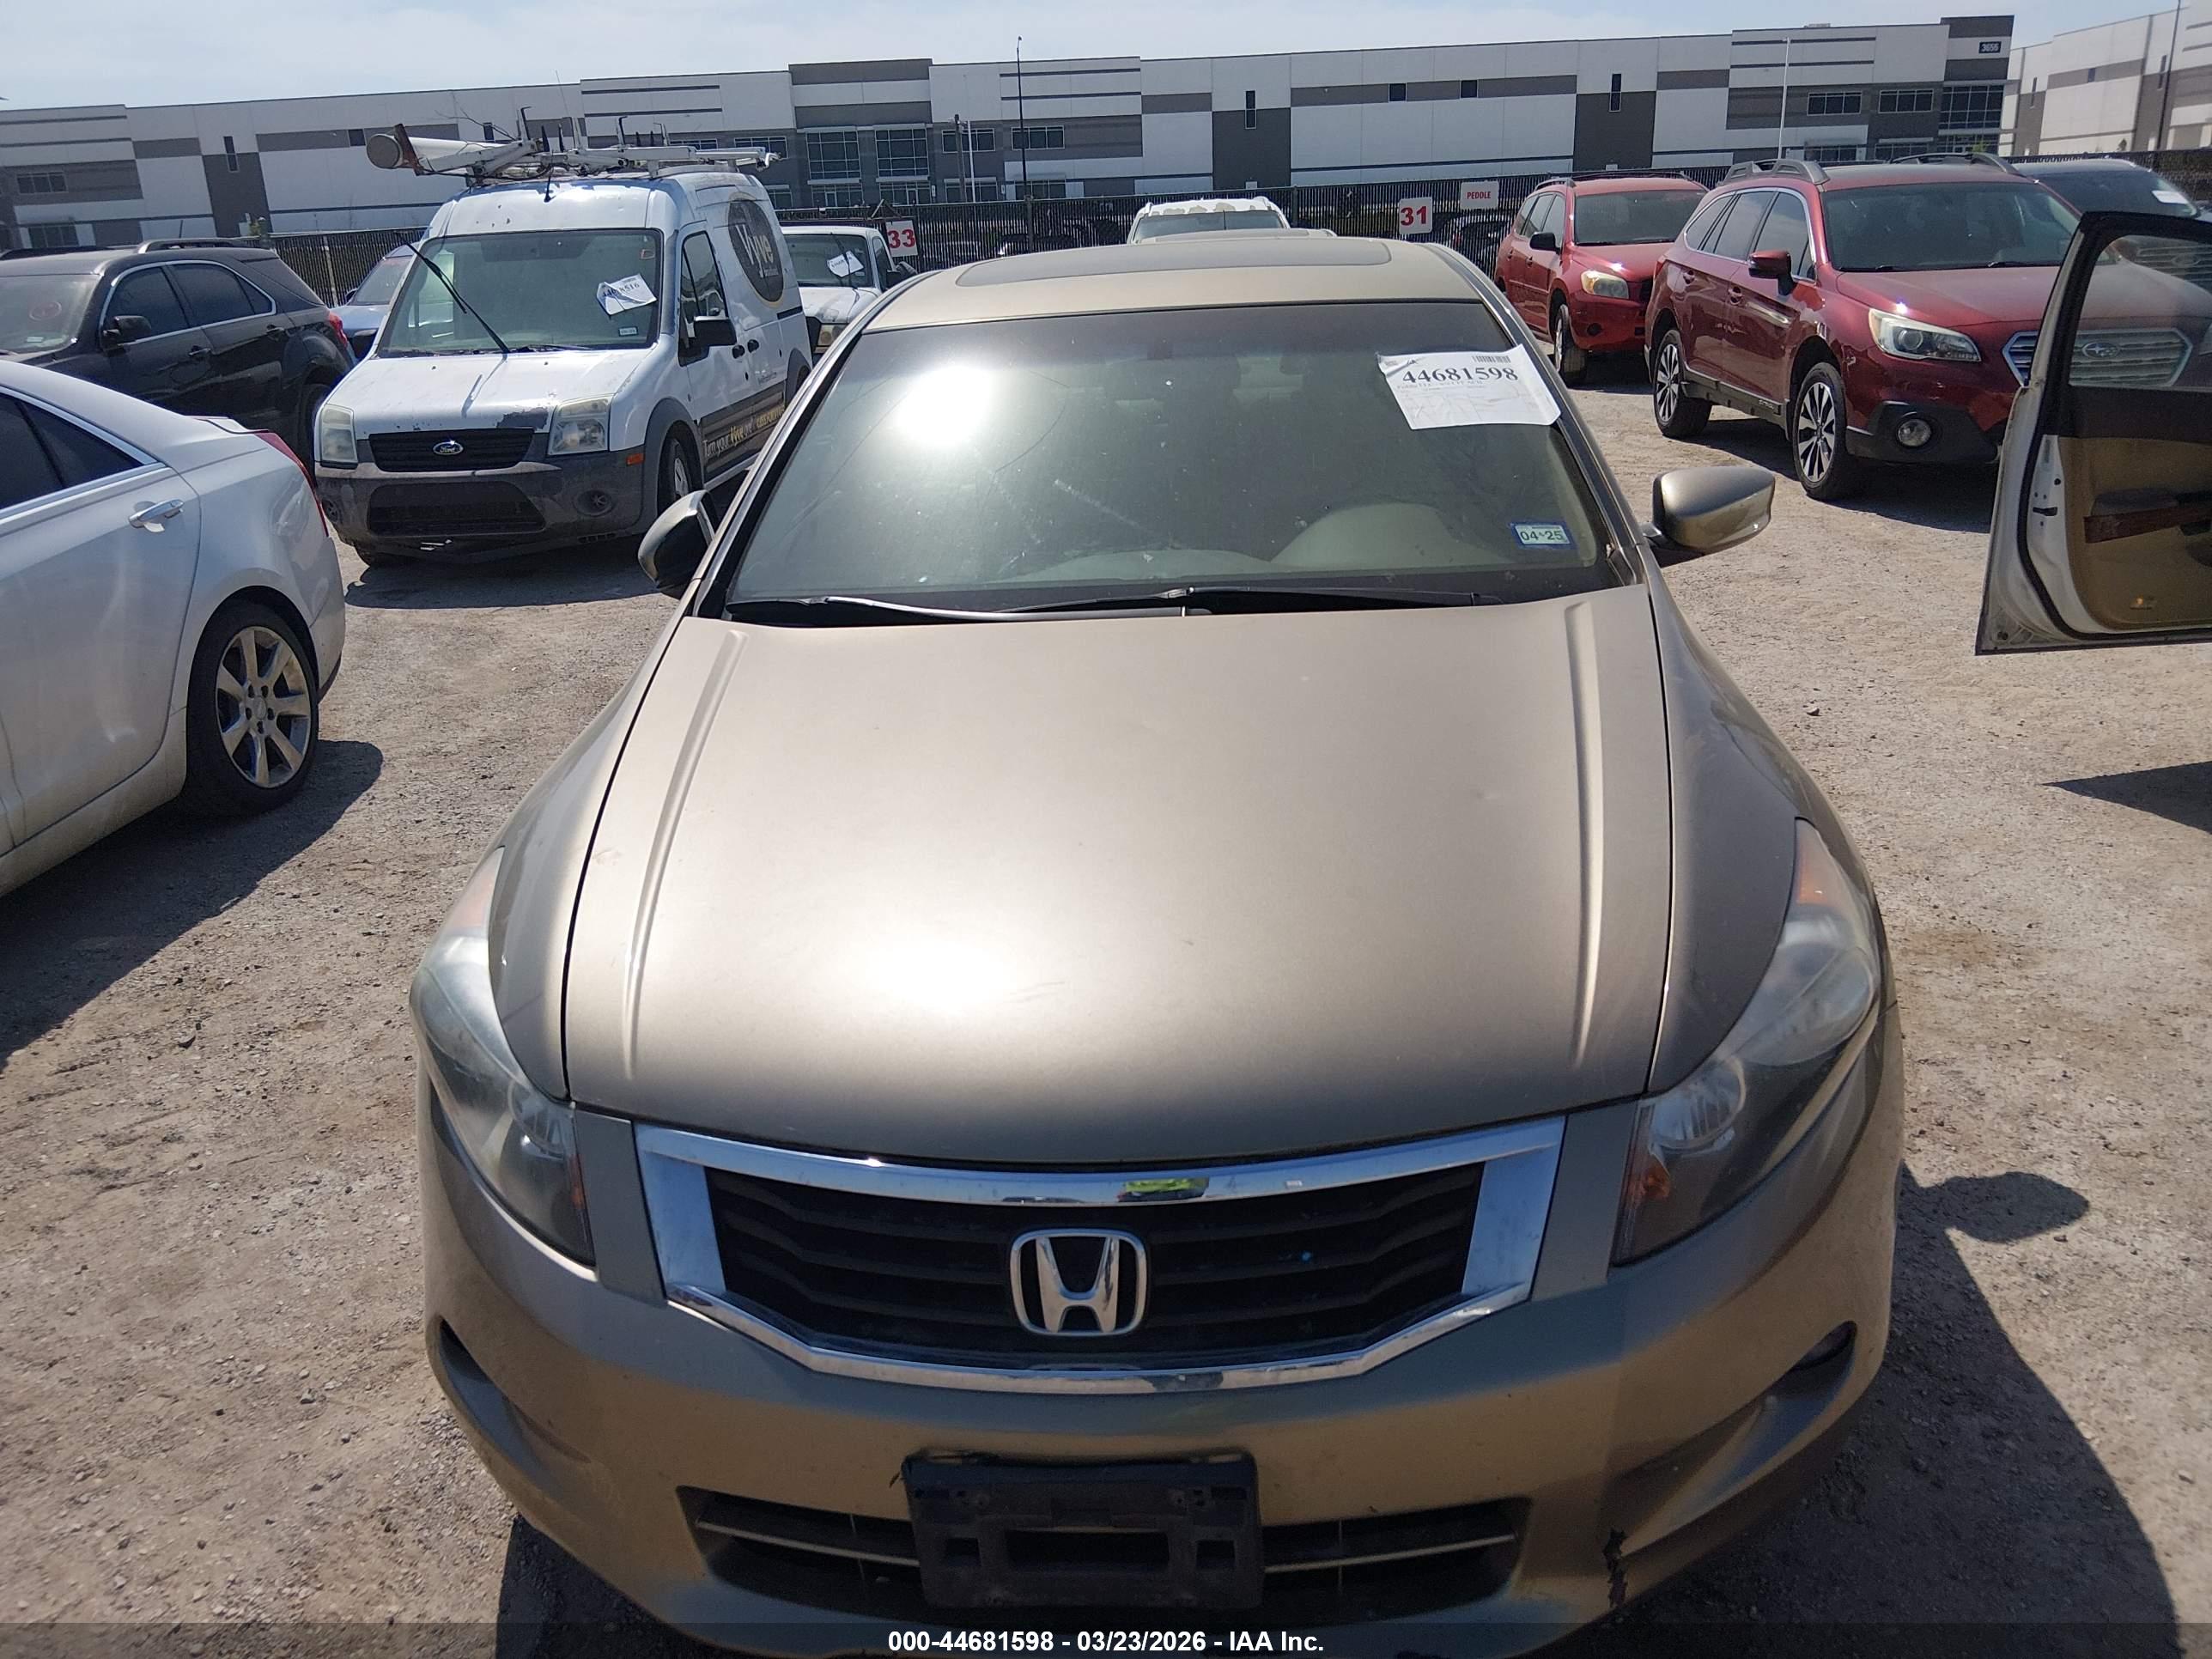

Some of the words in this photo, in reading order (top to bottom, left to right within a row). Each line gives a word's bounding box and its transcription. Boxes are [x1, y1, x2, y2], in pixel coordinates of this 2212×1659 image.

[1467, 191, 1492, 199] PEDDLE
[1401, 206, 1427, 226] 31
[887, 229, 915, 249] 33
[735, 224, 774, 278] Vyve
[1402, 367, 1519, 383] 44681598
